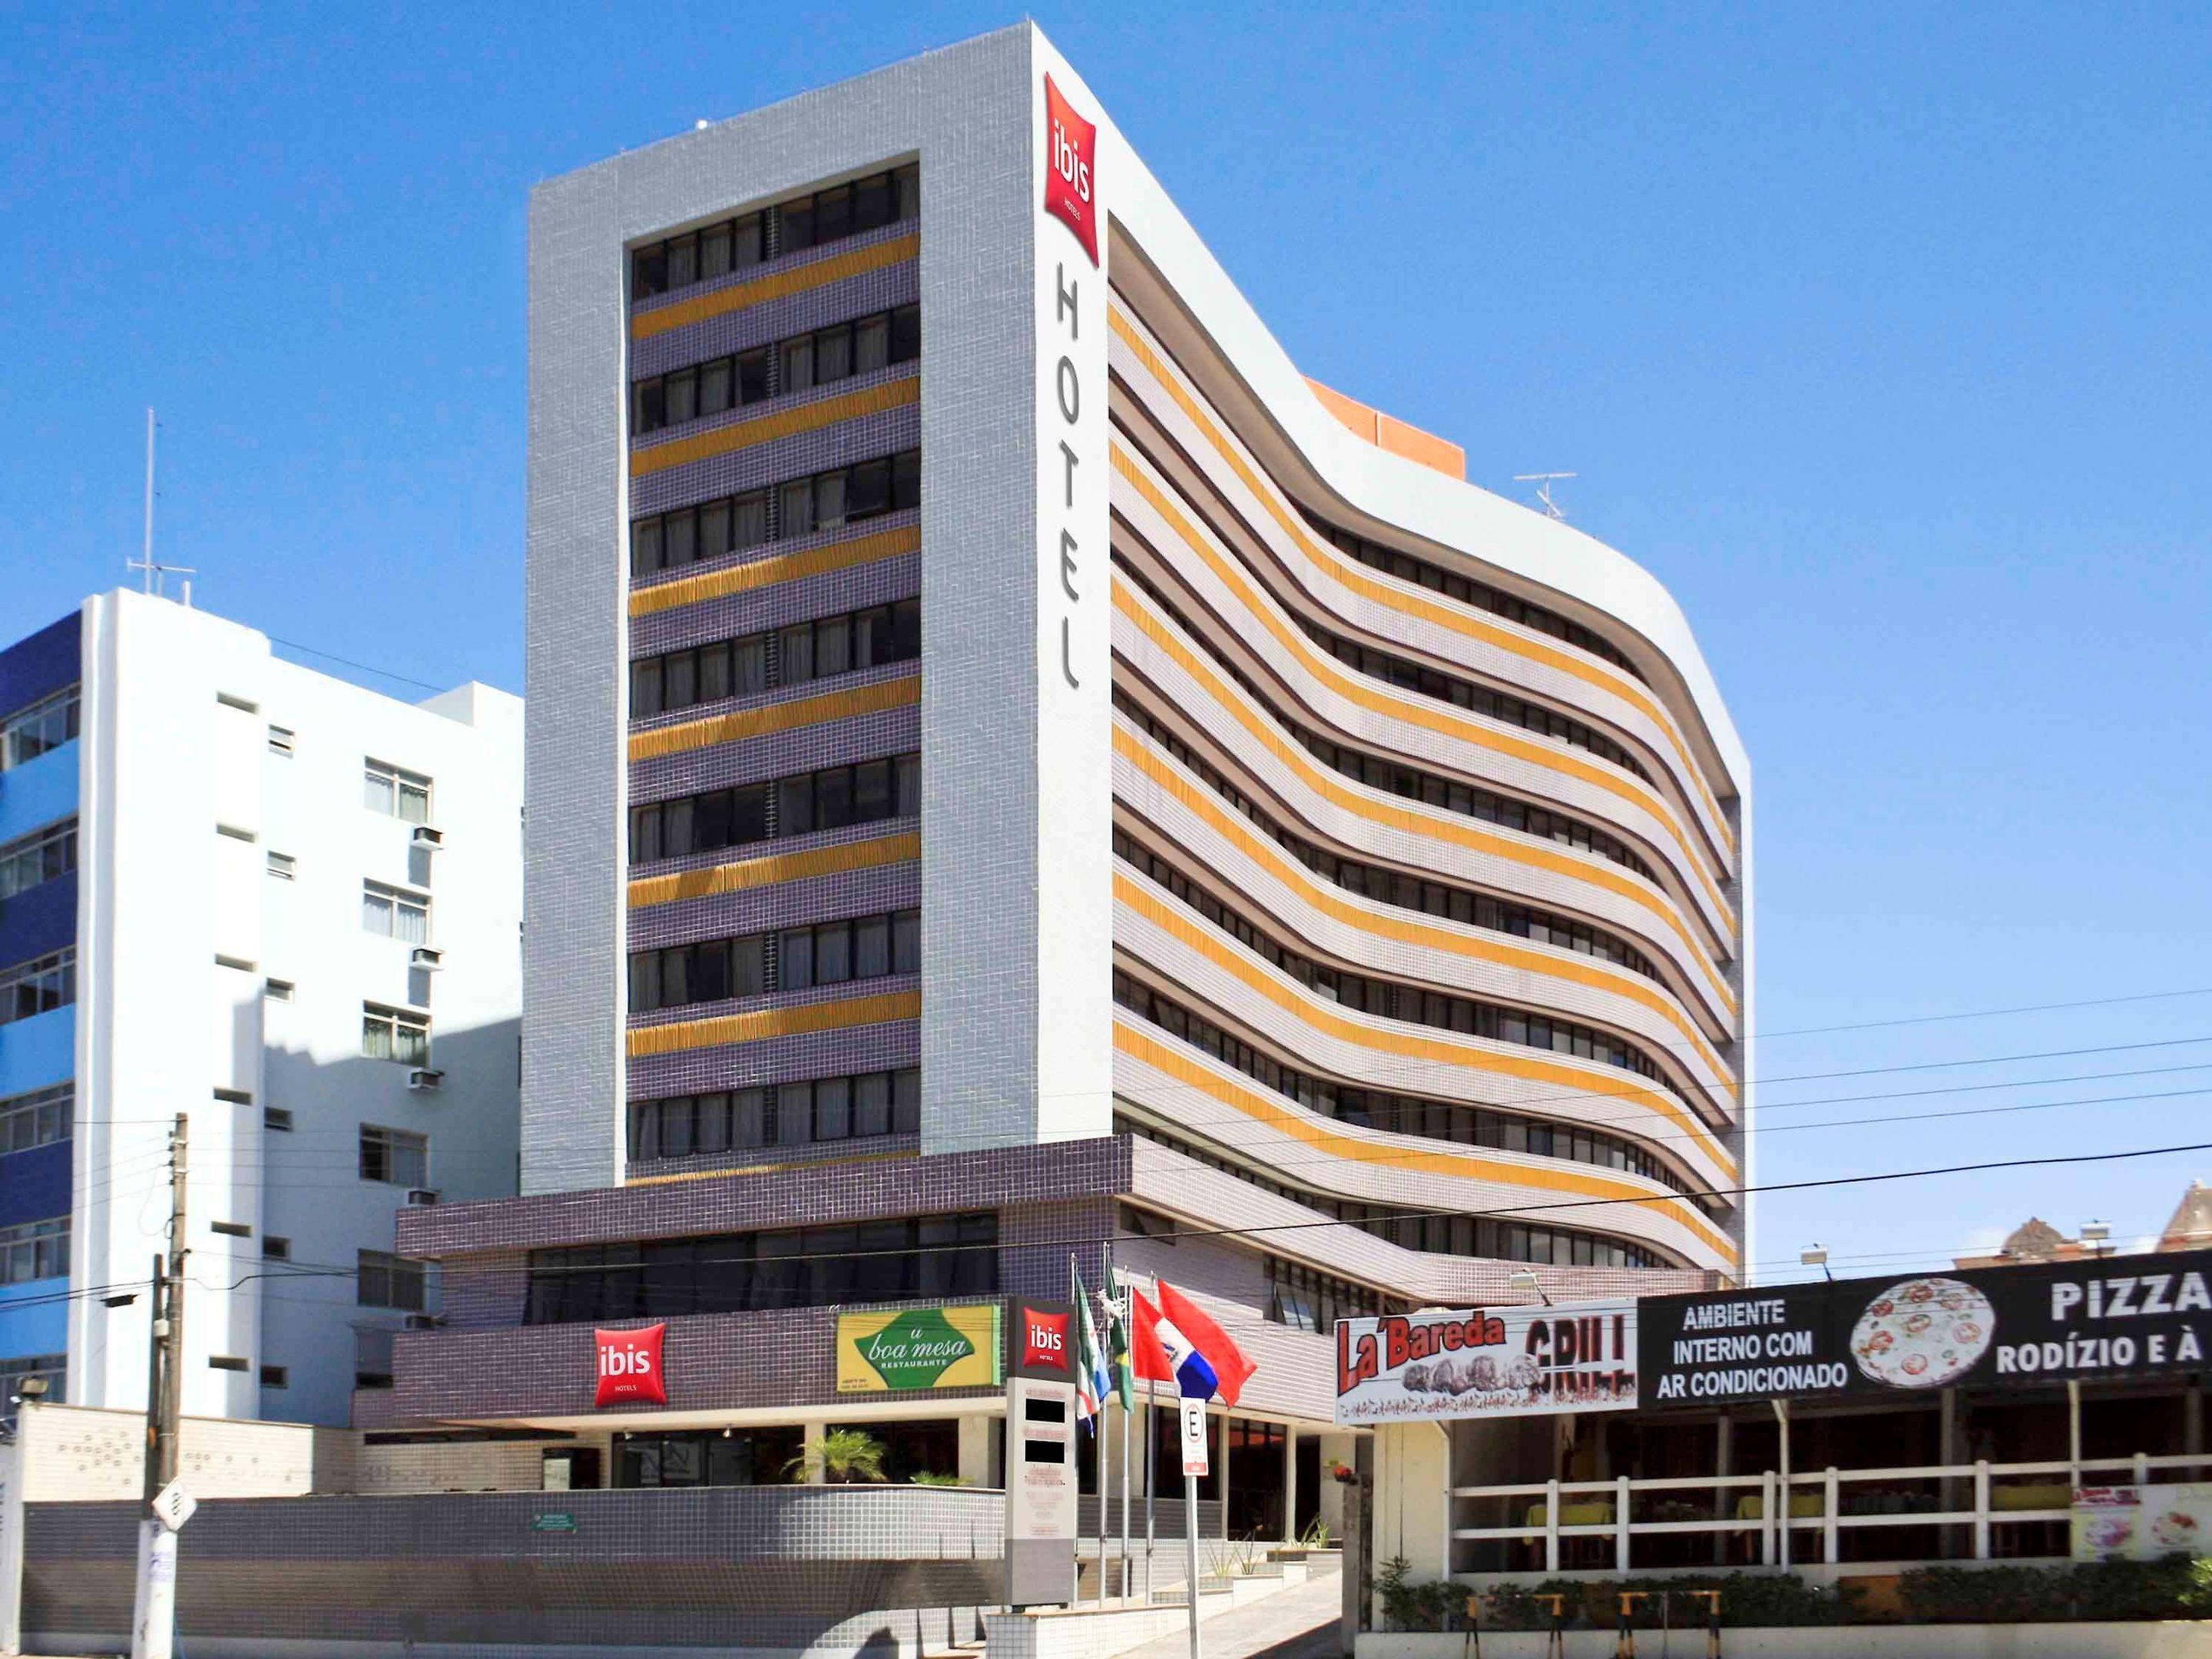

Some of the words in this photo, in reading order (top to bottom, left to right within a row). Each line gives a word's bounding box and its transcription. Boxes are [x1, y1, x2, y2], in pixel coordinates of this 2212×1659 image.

[1054, 118, 1089, 203] ibis
[1057, 261, 1079, 690] HOTEL
[2051, 1272, 2212, 1321] PIZZA
[1682, 1299, 1786, 1331] AMBIENTE
[868, 1333, 908, 1360] boa
[911, 1339, 967, 1358] mesa
[1031, 1324, 1061, 1350] ibis
[1337, 1320, 1379, 1398] La
[1377, 1310, 1506, 1371] Bareda
[1673, 1334, 1761, 1365] INTERNO
[1766, 1330, 1813, 1358] COM
[1997, 1330, 2136, 1374] RODÍZIO
[2147, 1333, 2165, 1363] E
[2175, 1324, 2203, 1362] À
[601, 1343, 651, 1376] ibis
[881, 1359, 947, 1369] RESTAURANTE
[1656, 1374, 1687, 1399] AR
[1690, 1362, 1849, 1398] CONDICIONADO
[1189, 1411, 1198, 1437] E
